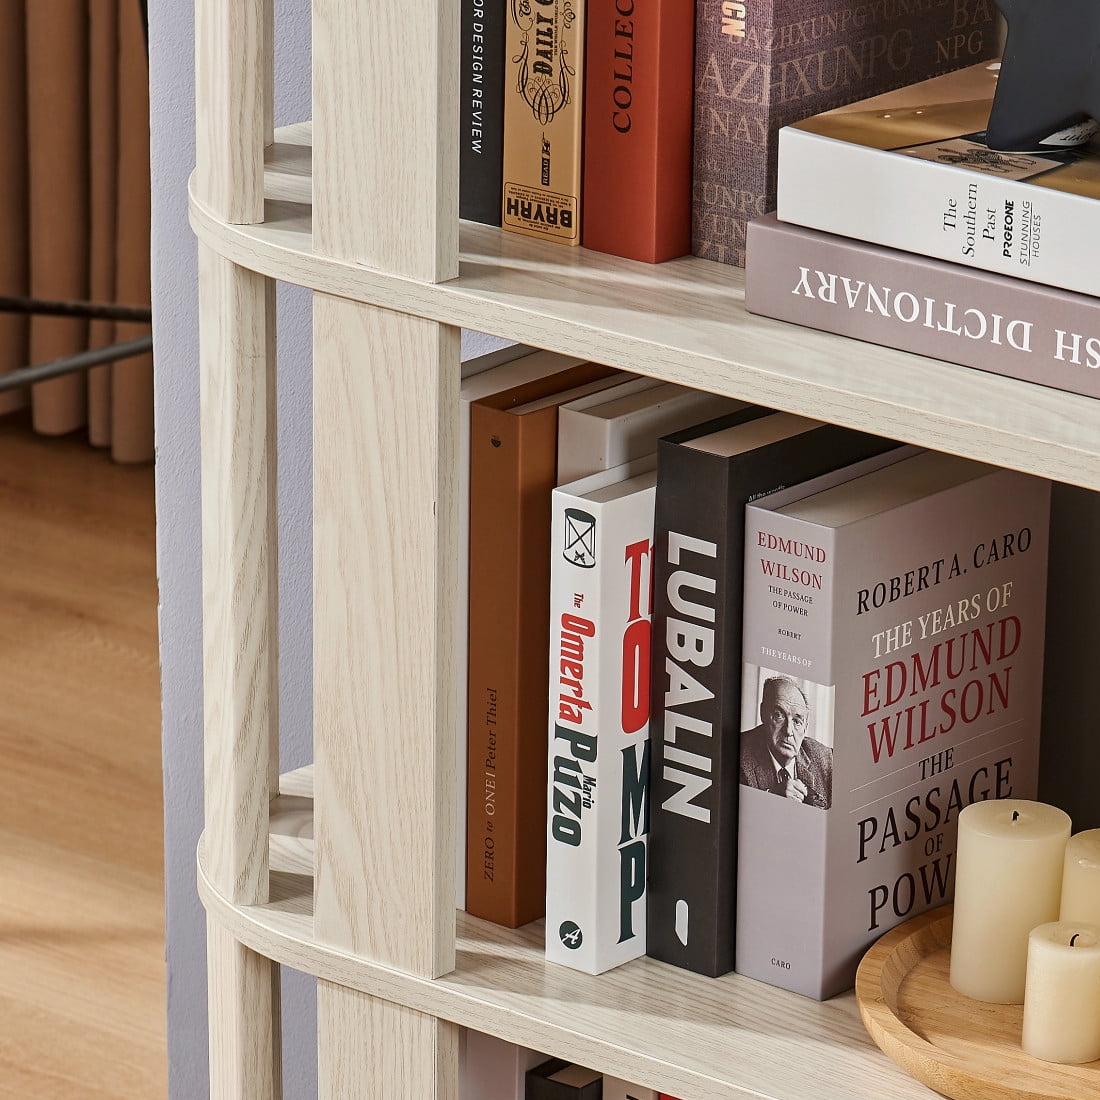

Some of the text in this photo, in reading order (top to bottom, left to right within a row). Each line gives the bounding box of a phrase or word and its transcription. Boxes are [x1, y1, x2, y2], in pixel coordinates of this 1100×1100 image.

[472, 23, 484, 80] DESIGN
[533, 12, 554, 77] DAILY
[471, 88, 483, 154] REVIEW
[506, 197, 573, 229] BRYRH
[943, 198, 958, 232] The
[961, 182, 978, 258] Southern
[982, 207, 998, 242] Past
[1019, 200, 1030, 266] STUNNING
[1032, 214, 1042, 258] HOUSES
[790, 265, 1034, 353] DICTIONARY
[757, 530, 827, 564] EDMUND
[760, 558, 823, 590] WILSON
[855, 527, 1033, 616] ROBERT A. CARO
[573, 592, 585, 609] The
[768, 584, 814, 605] THE PASSAGE
[772, 600, 809, 617] OF POWER
[777, 627, 802, 641] ROBERT
[871, 581, 1013, 659] THE YEARS OF
[558, 612, 597, 725] Omerta
[661, 530, 718, 825] LUBALIN
[760, 646, 776, 657] THE
[776, 650, 799, 665] YEARS
[860, 615, 1023, 718] EDMUND
[486, 687, 498, 727] Thiel
[866, 666, 1013, 764] WILSON
[485, 730, 498, 771] Peter
[918, 747, 955, 781] THE
[551, 720, 599, 848] Puzo
[582, 774, 598, 810] Mario
[856, 757, 1013, 864] PASSAGE
[483, 835, 496, 883] ZERO
[924, 832, 945, 857] OF
[867, 853, 953, 932] POW
[771, 957, 791, 971] CARO
